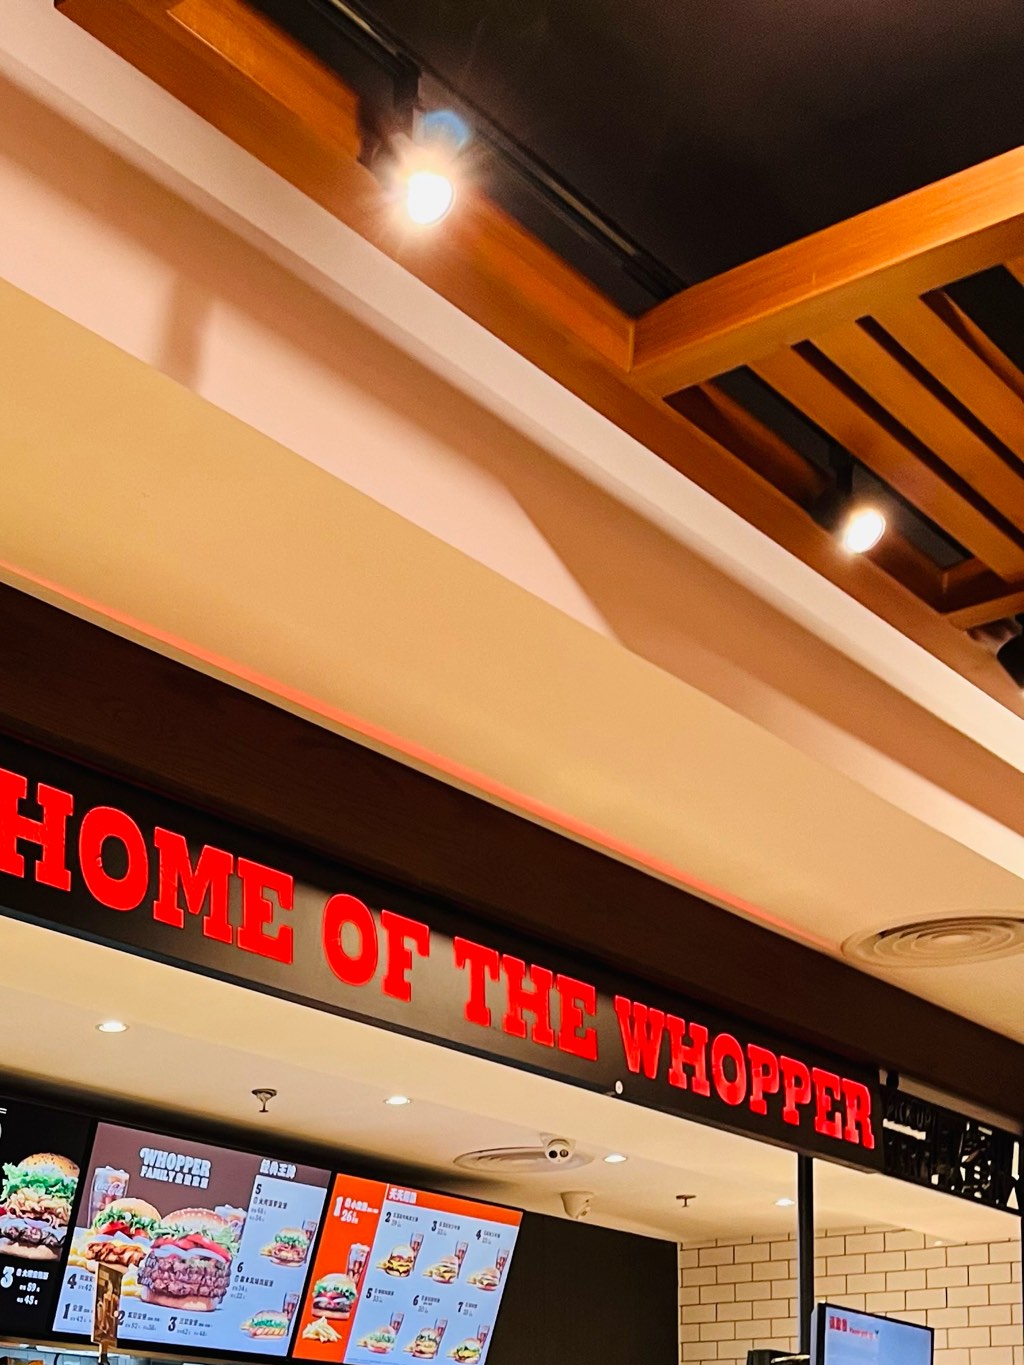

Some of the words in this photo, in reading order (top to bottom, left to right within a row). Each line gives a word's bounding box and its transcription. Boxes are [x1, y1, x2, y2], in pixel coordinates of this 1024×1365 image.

[323, 893, 429, 1003] OF
[454, 935, 598, 1063] THE
[614, 995, 876, 1151] WHOPPER
[139, 1147, 212, 1178] WHOPPER
[140, 1165, 175, 1184] FAMILY
[255, 1183, 263, 1195] 5
[334, 1196, 344, 1217] 1
[385, 1212, 392, 1223] 2
[432, 1221, 438, 1232] 3
[476, 1230, 482, 1240] 4
[237, 1261, 245, 1273] 6
[0, 1266, 15, 1288] 3
[67, 1273, 77, 1289] 4
[366, 1288, 373, 1299] 5
[413, 1295, 420, 1306] 6
[62, 1303, 71, 1320] 1
[458, 1302, 464, 1313] 7
[116, 1309, 125, 1325] 2
[168, 1316, 178, 1332] 3
